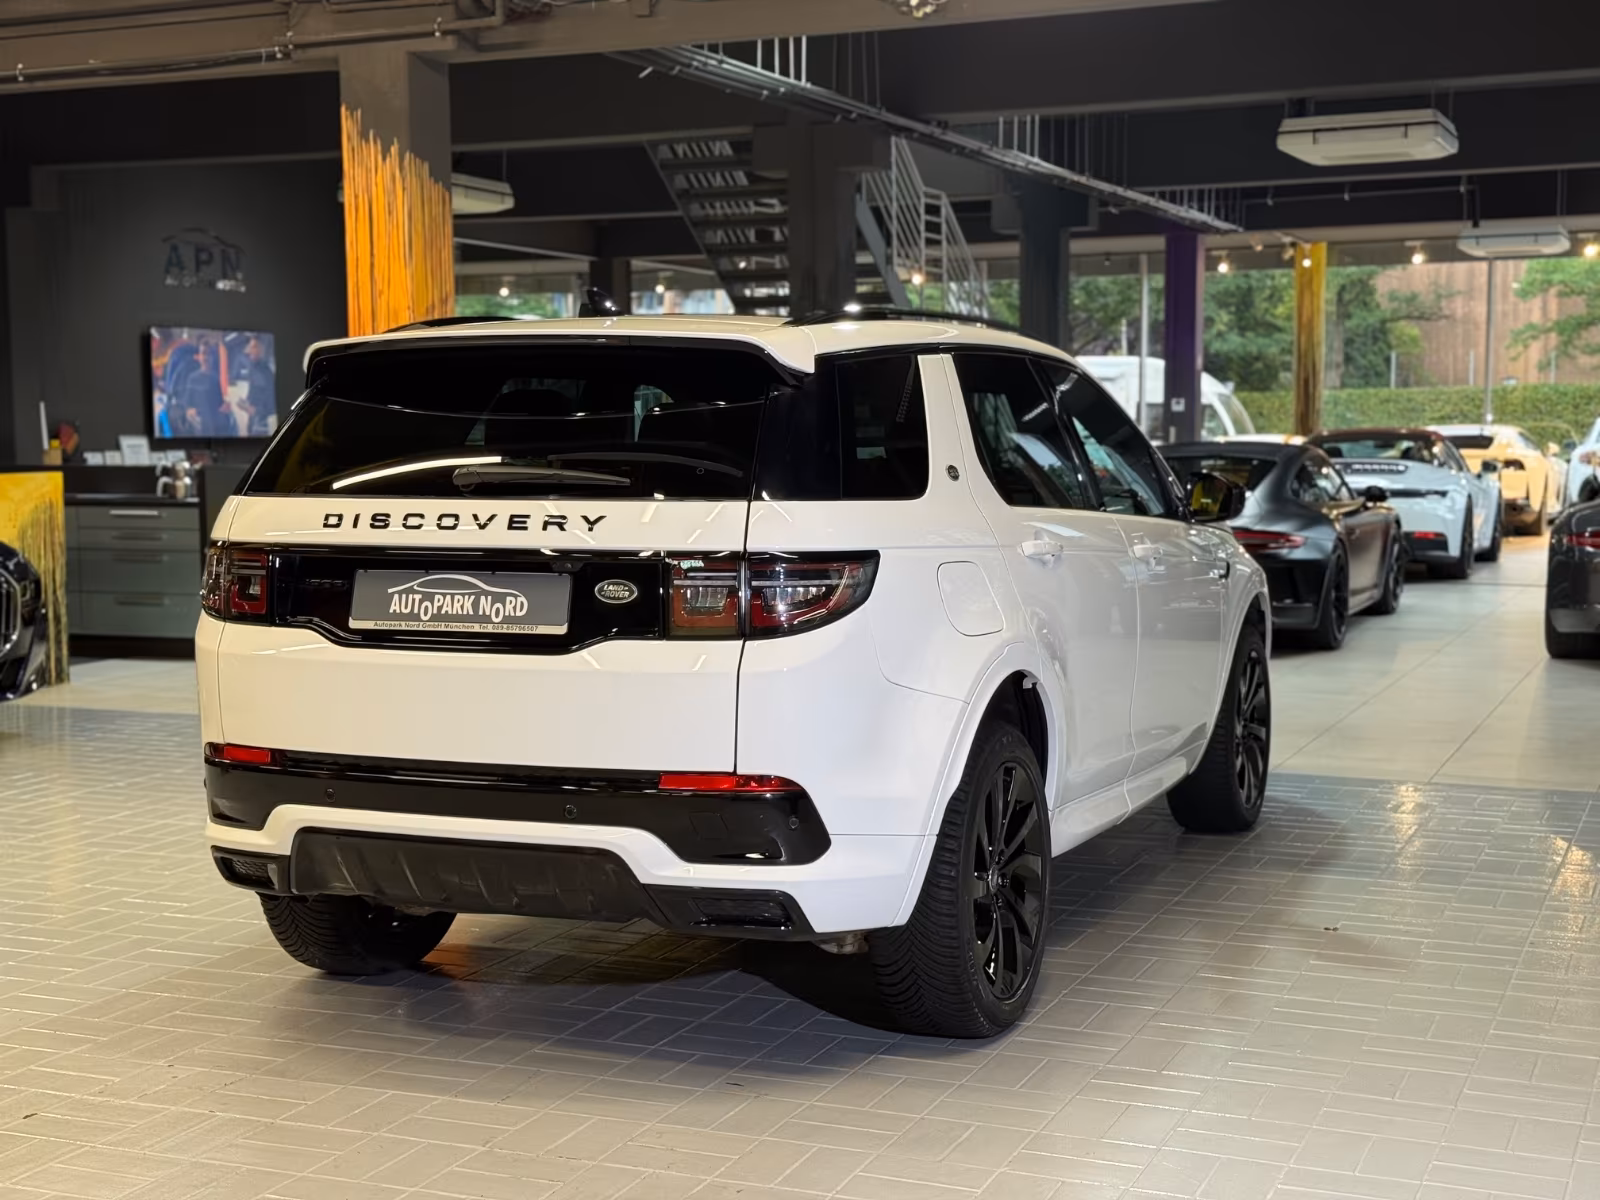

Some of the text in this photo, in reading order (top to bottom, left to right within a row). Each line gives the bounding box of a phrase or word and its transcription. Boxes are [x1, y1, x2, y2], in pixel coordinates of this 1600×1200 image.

[164, 242, 243, 280] APN
[322, 513, 607, 532] DISCOVERY
[389, 593, 529, 623] AUTOPARK NORD
[373, 621, 403, 629] Autopark
[422, 622, 443, 630] GmbH
